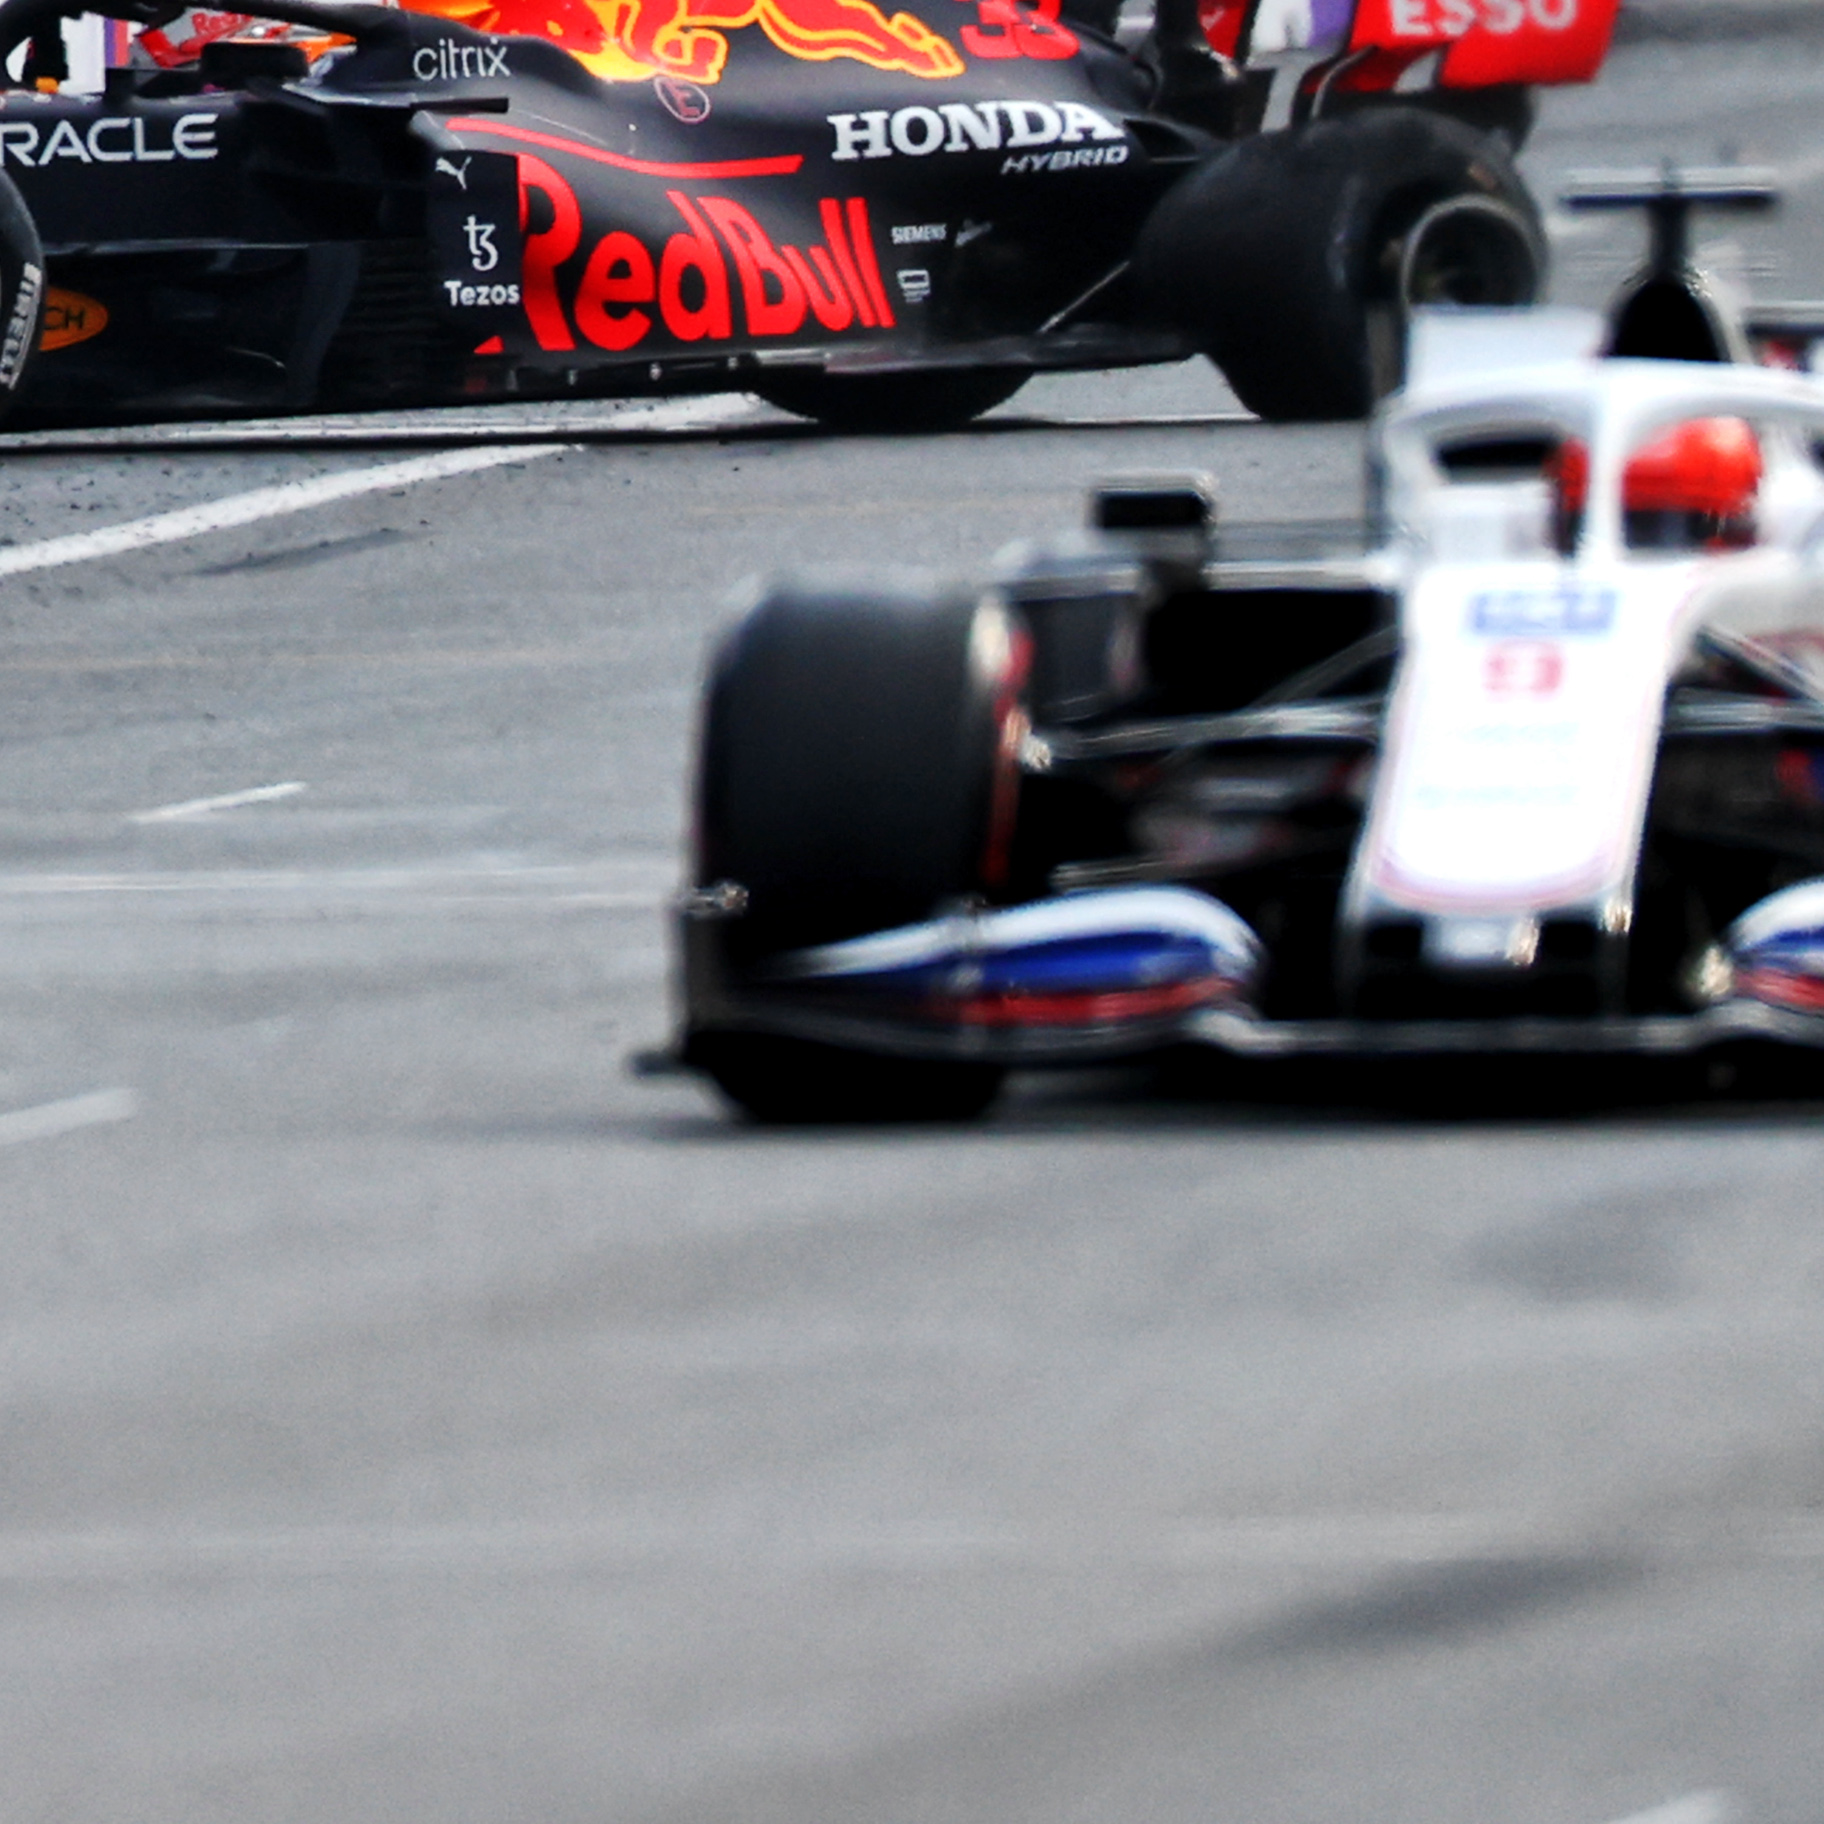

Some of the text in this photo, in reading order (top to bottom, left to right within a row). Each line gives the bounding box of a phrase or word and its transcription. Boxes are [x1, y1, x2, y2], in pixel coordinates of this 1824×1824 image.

[412, 40, 511, 82] citrix
[827, 100, 1125, 162] HONDA
[1001, 145, 1129, 175] HYBRID
[445, 279, 521, 307] Tezos
